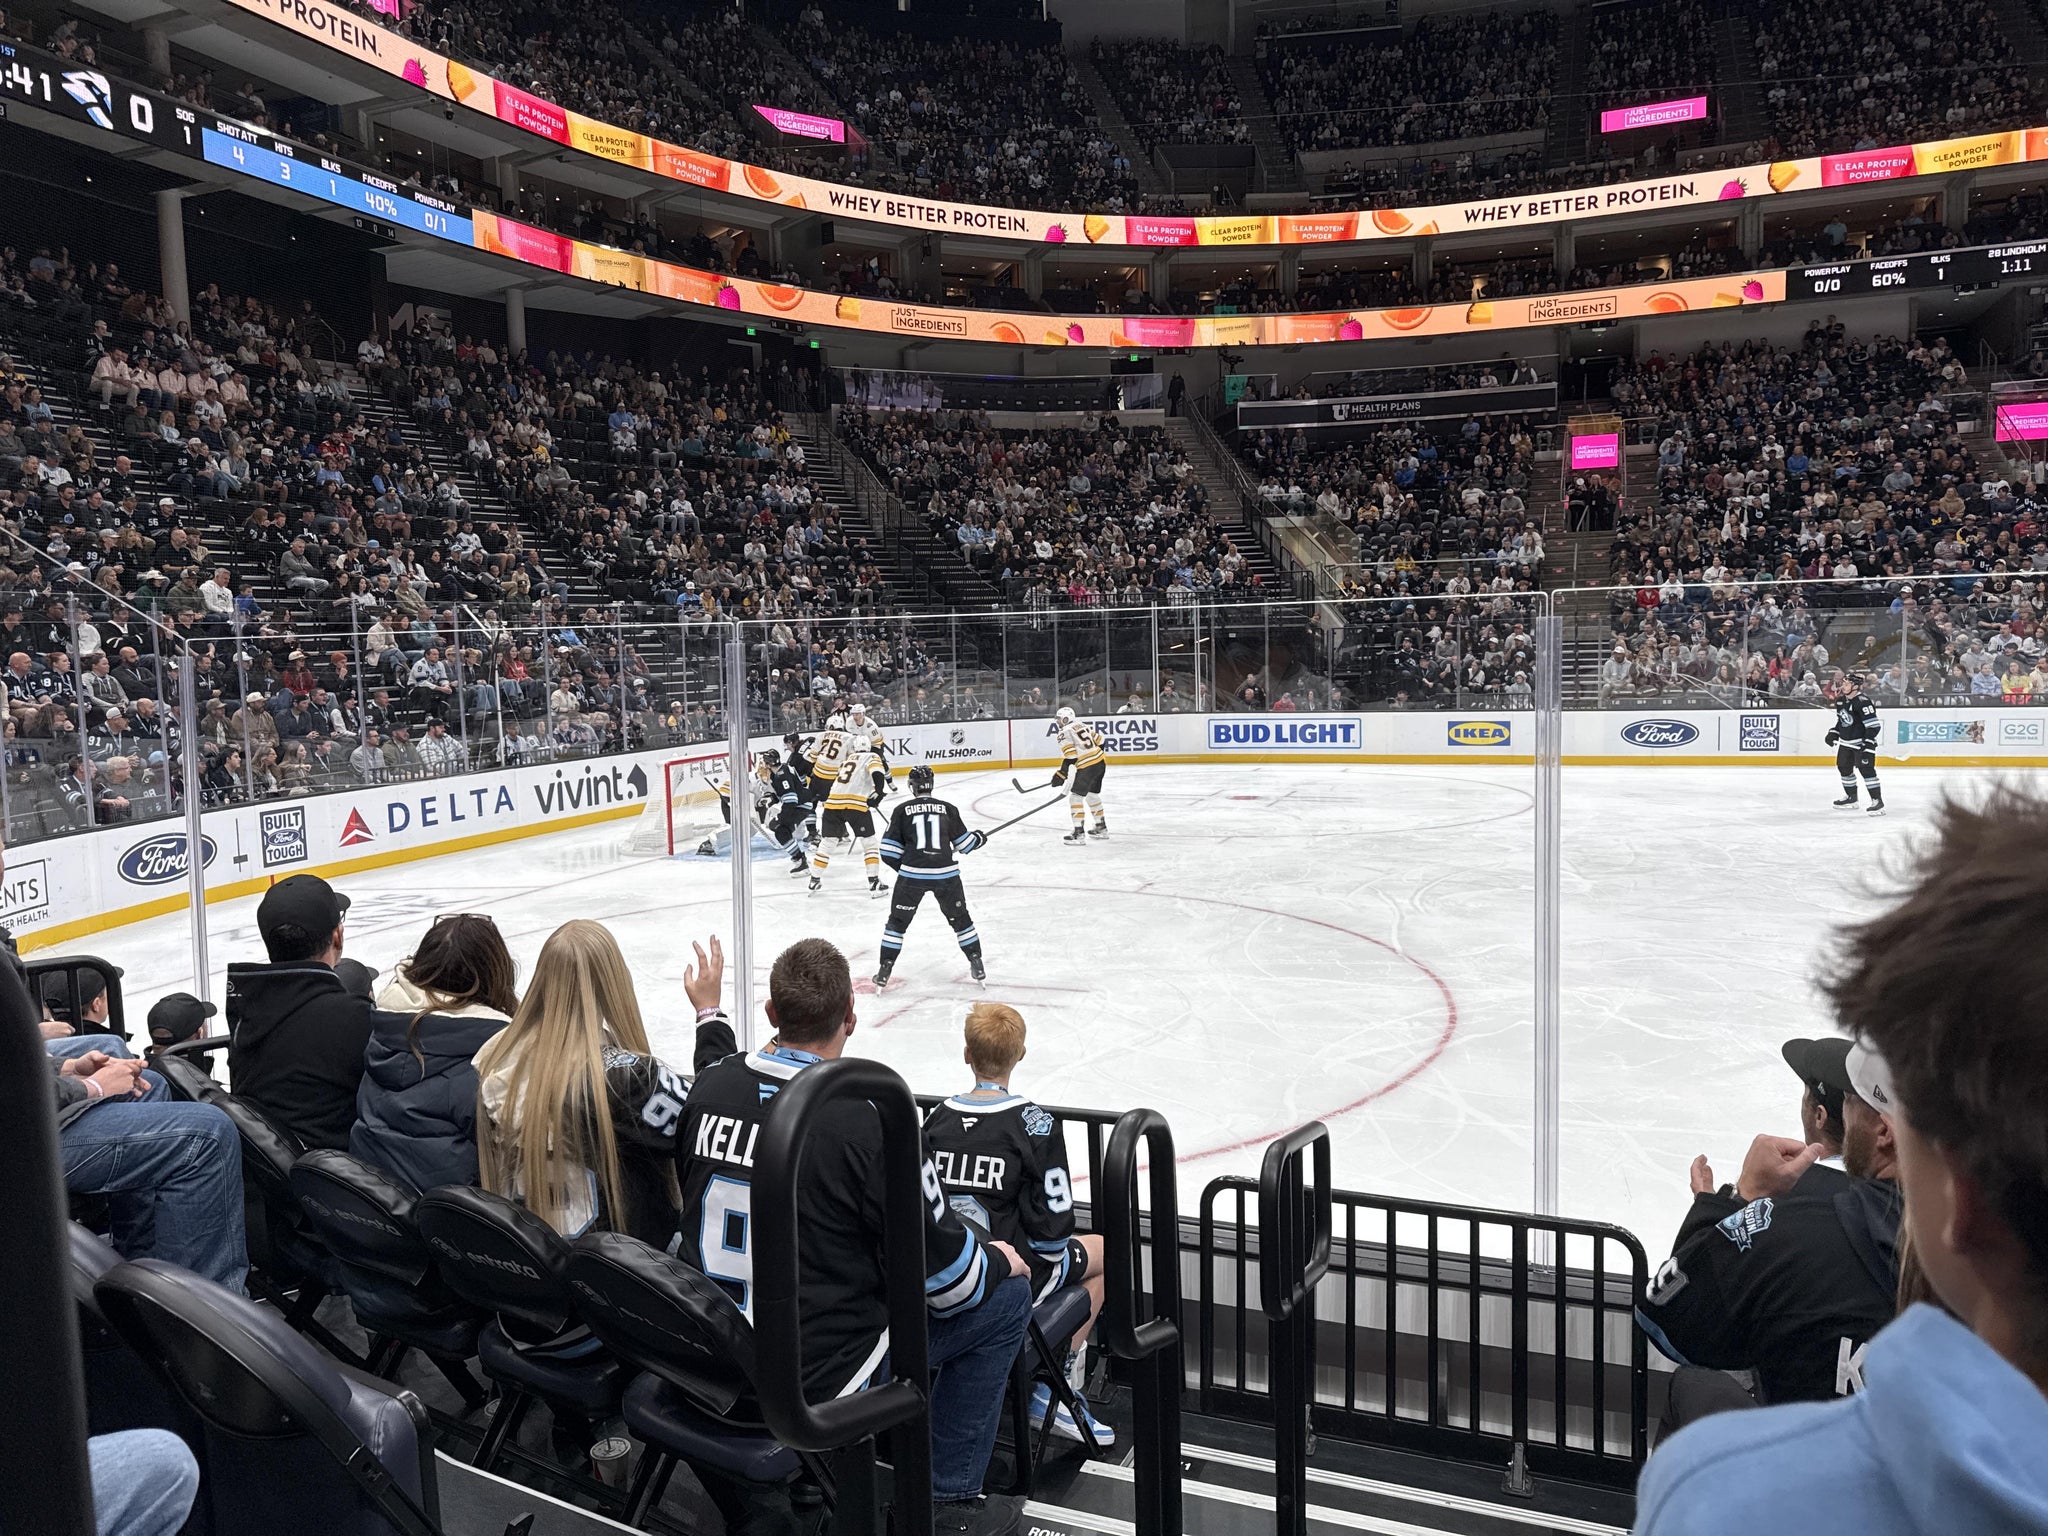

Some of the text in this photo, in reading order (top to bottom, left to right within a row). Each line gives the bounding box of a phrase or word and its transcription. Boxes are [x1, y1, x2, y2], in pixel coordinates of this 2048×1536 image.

[0, 44, 16, 58] 1ST
[0, 62, 52, 102] :41
[129, 94, 154, 134] 0
[175, 107, 195, 124] SOG
[505, 96, 564, 130] CLEAR PROTEIN
[777, 112, 795, 121] JUST
[1628, 107, 1649, 117] JUST
[1629, 108, 1689, 124] INGREDIENTS
[216, 121, 258, 145] SHOT ATT
[518, 114, 552, 136] POWDER
[777, 120, 830, 134] INGREDIENTS
[183, 125, 191, 145] 1
[582, 132, 636, 149] CLEAR PROTEIN
[232, 146, 245, 165] 4
[274, 141, 294, 158] HITS
[594, 145, 626, 157] POWDER
[1933, 141, 2002, 163] CLEAR PROTEIN
[321, 158, 341, 174] BLKS
[665, 155, 717, 179] CLEAR PROTEIN
[1834, 158, 1908, 172] CLEAR PROTEIN
[1949, 154, 1988, 169] POWDER
[280, 162, 291, 181] 3
[675, 168, 706, 185] POWDER
[1849, 169, 1891, 180] POWDER
[329, 178, 336, 196] 1
[362, 173, 398, 194] FACEOFFS
[365, 191, 398, 217] 40%
[414, 192, 456, 214] POWER PLAY
[1464, 181, 1699, 224] WHEY BETTER PROTEIN.
[829, 190, 1029, 233] WHEY BETTER PROTEIN.
[424, 212, 447, 233] 0/1
[1136, 224, 1192, 236] CLEAR PROTEIN
[1210, 223, 1262, 236] CLEAR PROTEIN
[1312, 224, 1344, 232] PROTEIN
[1147, 234, 1179, 244] POWDER
[1222, 233, 1251, 242] POWDER
[1930, 254, 1951, 264] BLKS
[1987, 243, 2047, 259] 28 LINDHOLM
[1804, 265, 1851, 278] POWER PLAY
[1870, 259, 1908, 270] FACEOFFS
[2001, 258, 2032, 273] 1:11
[1872, 271, 1906, 287] 60%
[1937, 268, 1944, 281] 1
[1814, 278, 1841, 293] 0/0
[1533, 298, 1558, 309] JUST
[1534, 302, 1612, 319] INGREDIENTS
[895, 307, 917, 317] JUST
[895, 317, 963, 333] INGREDIENTS
[1352, 404, 1387, 413] HEALTH
[1390, 401, 1421, 411] PLANS
[1046, 720, 1156, 737] ARICAN
[1744, 718, 1776, 729] BUILT
[1915, 724, 1948, 736] G2G
[2004, 723, 2039, 735] G2G
[1214, 724, 1355, 743] BUD LIGHT
[1454, 728, 1505, 739] IKEA
[1635, 723, 1685, 743] Ford
[1104, 736, 1158, 752] RESS
[1744, 738, 1776, 749] TOUGH
[925, 748, 992, 760] NHLSHOP.COM
[534, 765, 624, 815] vivint
[387, 785, 515, 834] DELTA
[905, 803, 947, 816] GUENTHER
[265, 812, 300, 832] BUILT
[274, 831, 294, 844] Ford
[912, 814, 942, 850] 11
[137, 841, 189, 878] Ford
[267, 844, 303, 862] TOUGH
[16, 909, 51, 927] HEALTH.
[934, 1151, 1006, 1191] ELLER
[1044, 1167, 1073, 1214] 9
